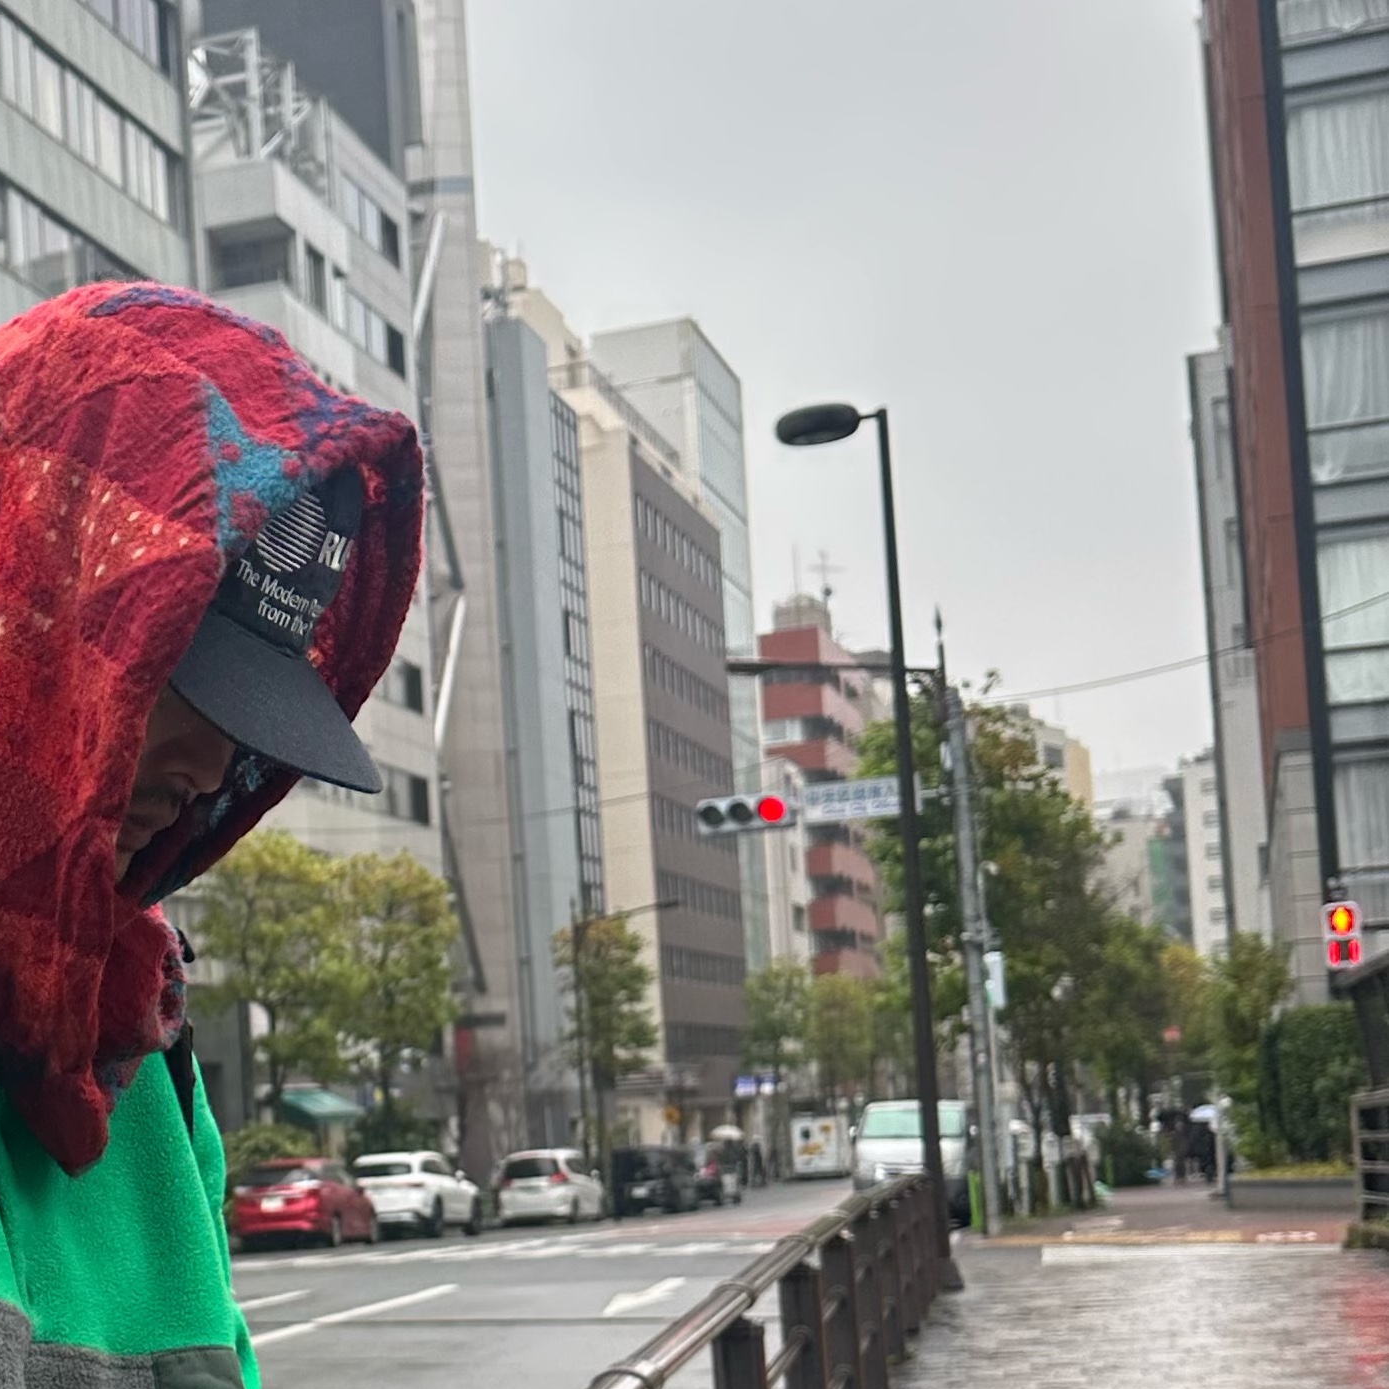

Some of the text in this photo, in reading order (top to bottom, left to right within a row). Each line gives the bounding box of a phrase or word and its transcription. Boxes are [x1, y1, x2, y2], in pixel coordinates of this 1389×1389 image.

[236, 558, 260, 587] The
[261, 574, 309, 612] Modern
[257, 597, 291, 628] from
